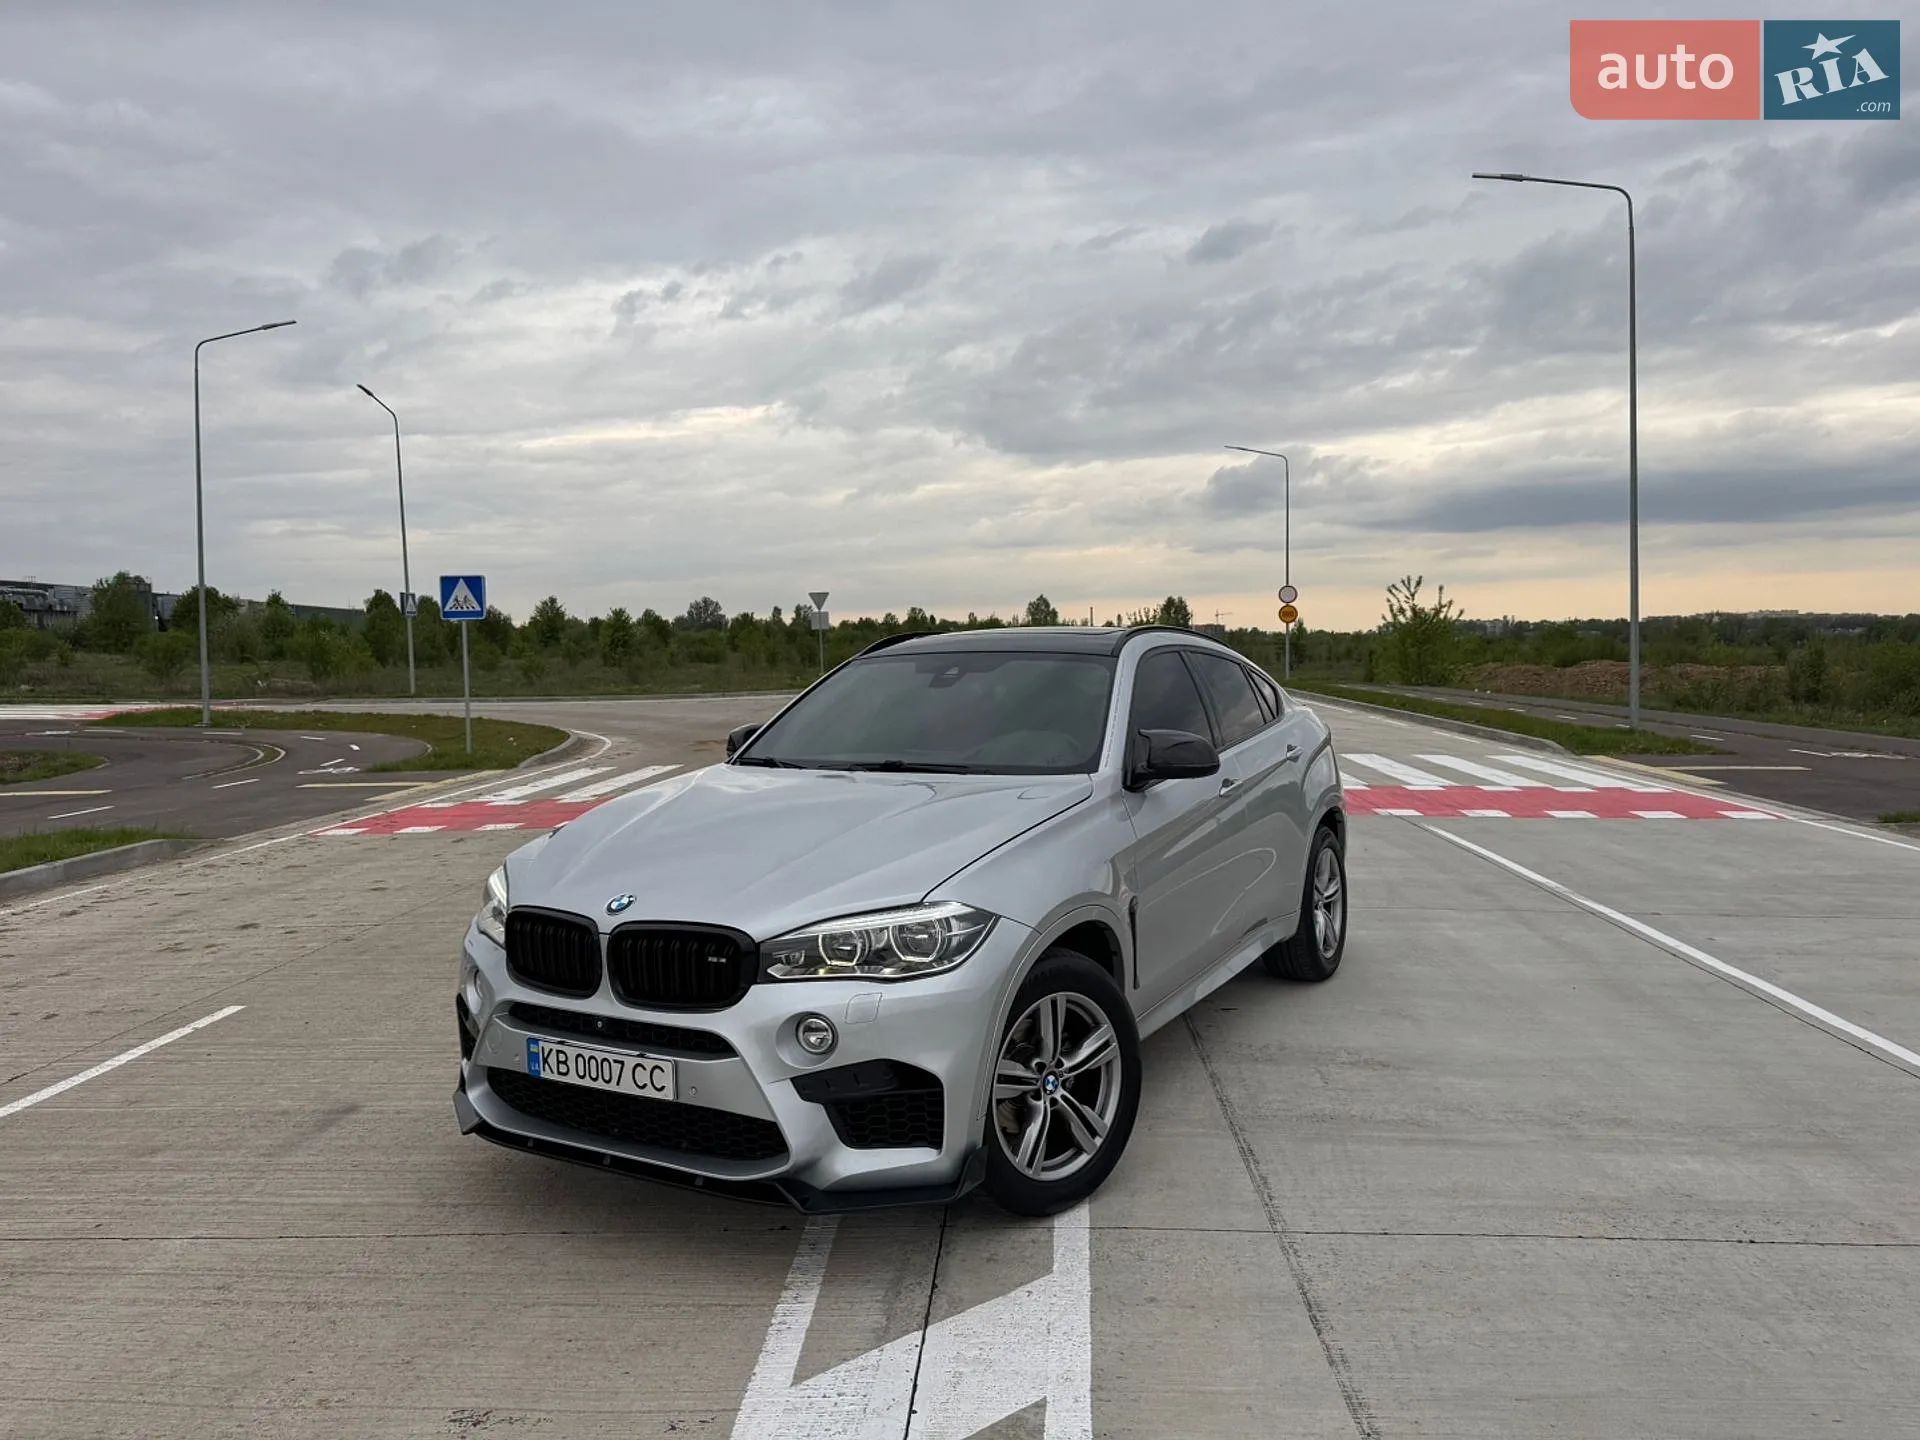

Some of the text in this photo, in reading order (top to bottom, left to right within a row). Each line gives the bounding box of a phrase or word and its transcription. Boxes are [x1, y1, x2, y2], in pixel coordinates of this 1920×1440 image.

[541, 1046, 666, 1092] KB 0007 CC
